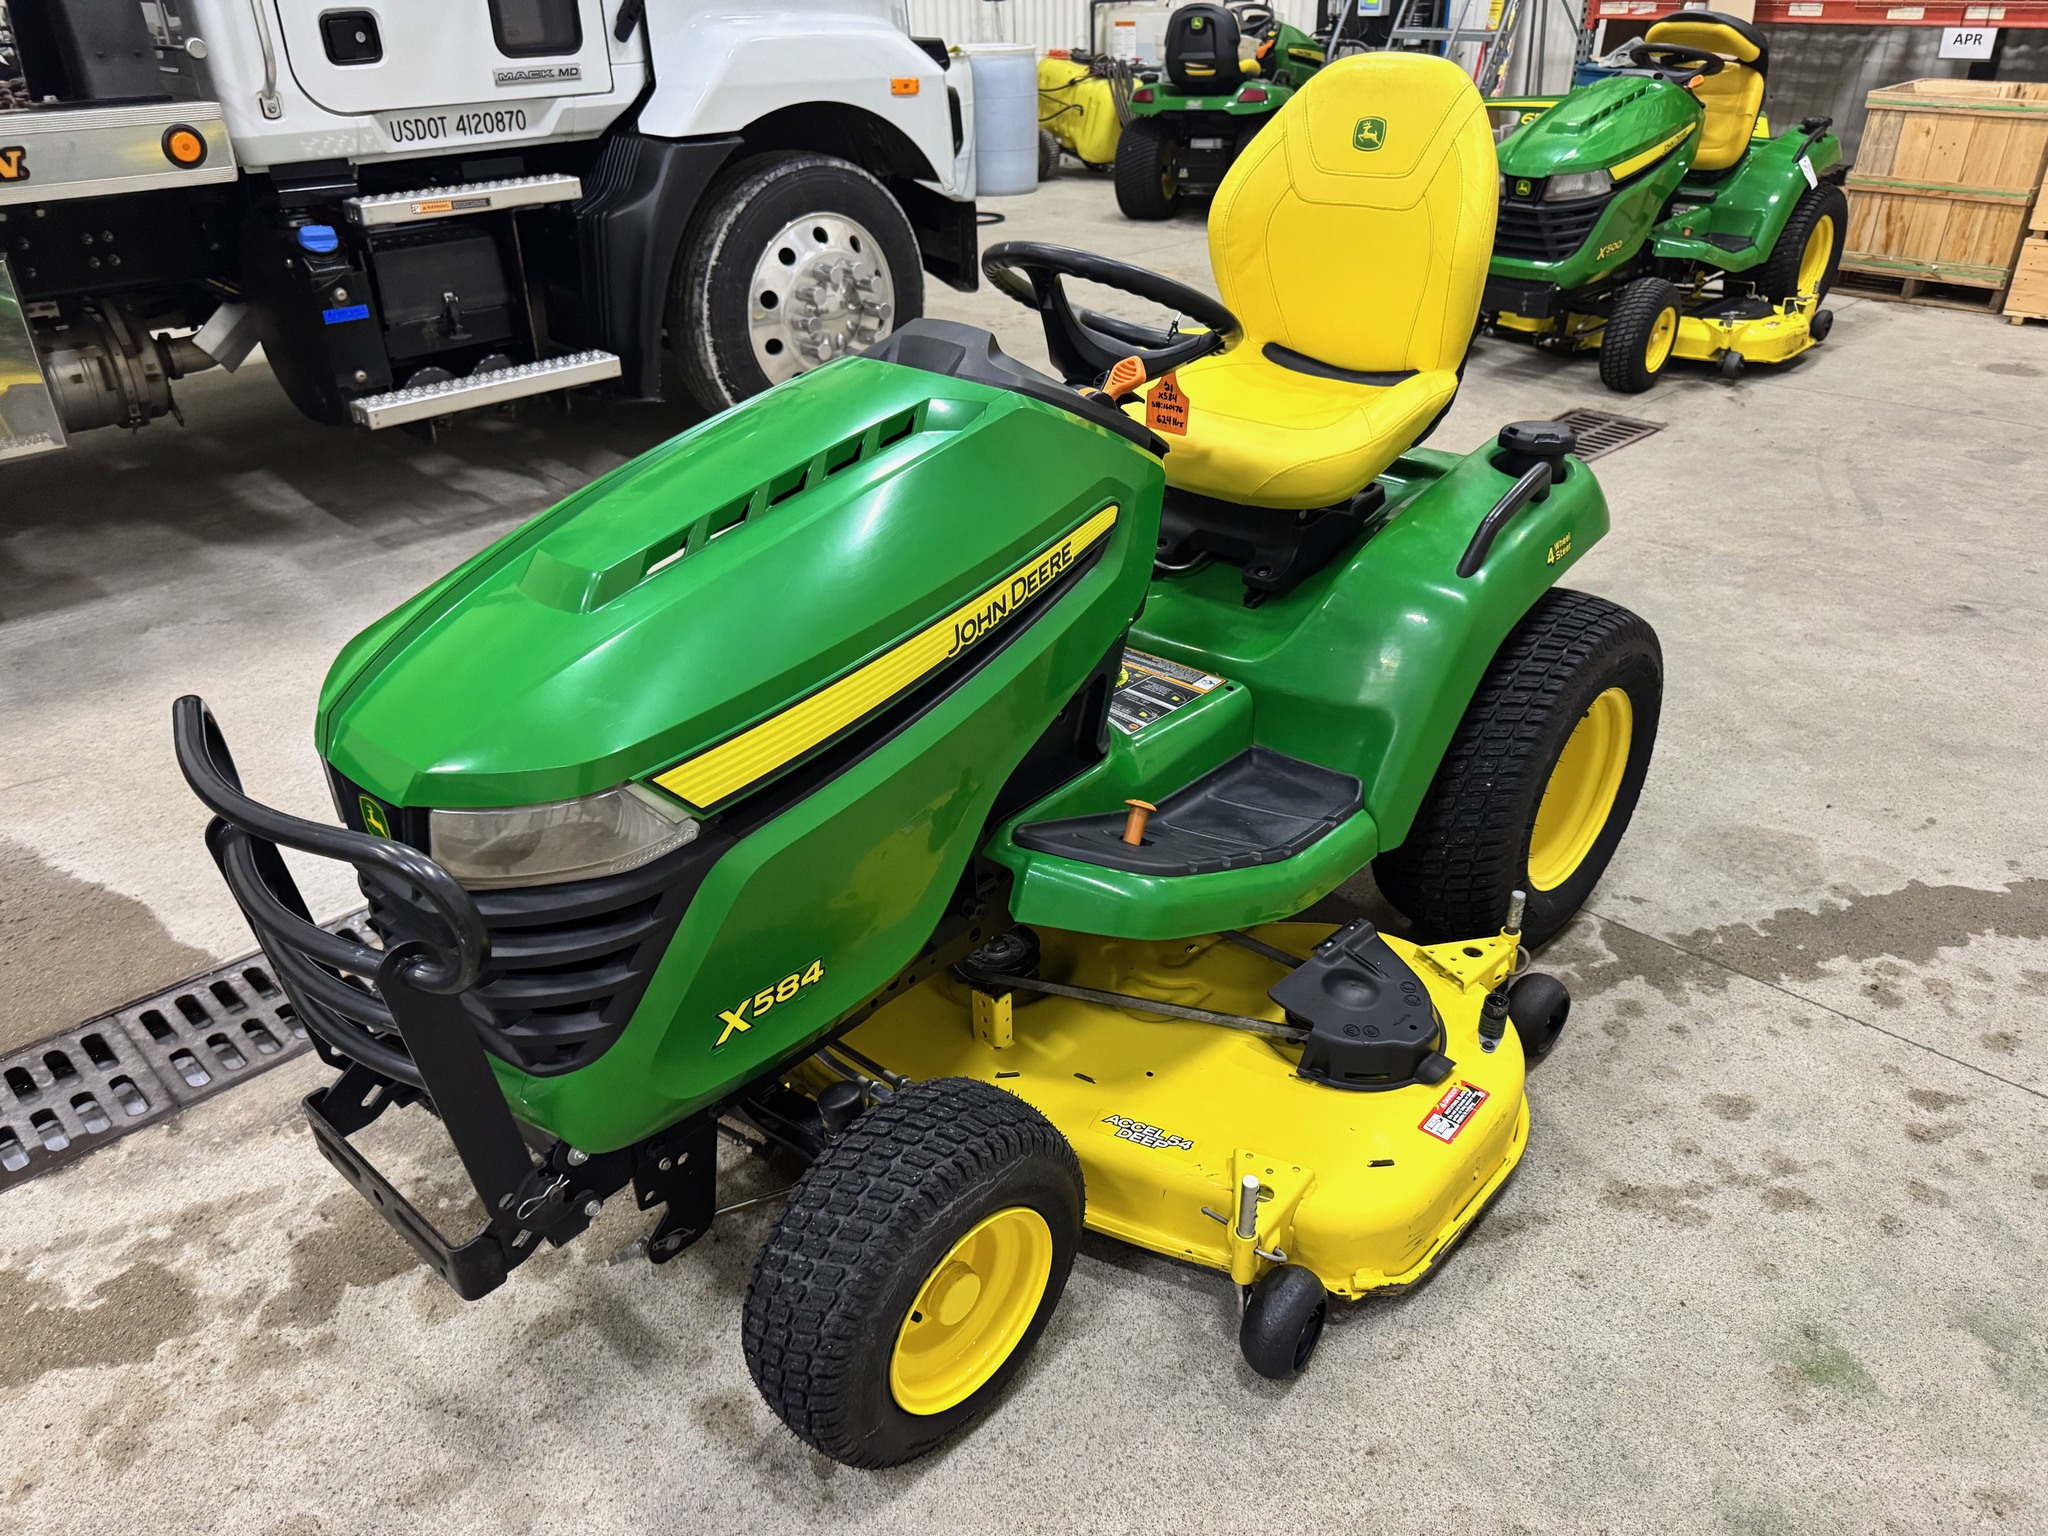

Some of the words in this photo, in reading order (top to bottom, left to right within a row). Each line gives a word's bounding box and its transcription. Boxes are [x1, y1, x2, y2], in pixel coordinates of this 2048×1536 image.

[1953, 33, 1983, 45] APR
[498, 69, 555, 82] MACK
[558, 67, 579, 77] MD
[389, 116, 447, 143] USDOT
[456, 109, 527, 136] 4120870
[1596, 240, 1623, 260] X500
[1156, 414, 1172, 425] 624
[1547, 546, 1555, 564] 4
[1554, 532, 1571, 550] Wheel
[1556, 543, 1571, 560] Steer
[948, 593, 1008, 657] JOHN
[1011, 540, 1074, 609] DEERE
[711, 957, 825, 1049] X584
[1101, 1114, 1166, 1141] ACCEL
[1166, 1134, 1194, 1150] 54
[1114, 1127, 1169, 1149] DEEP
